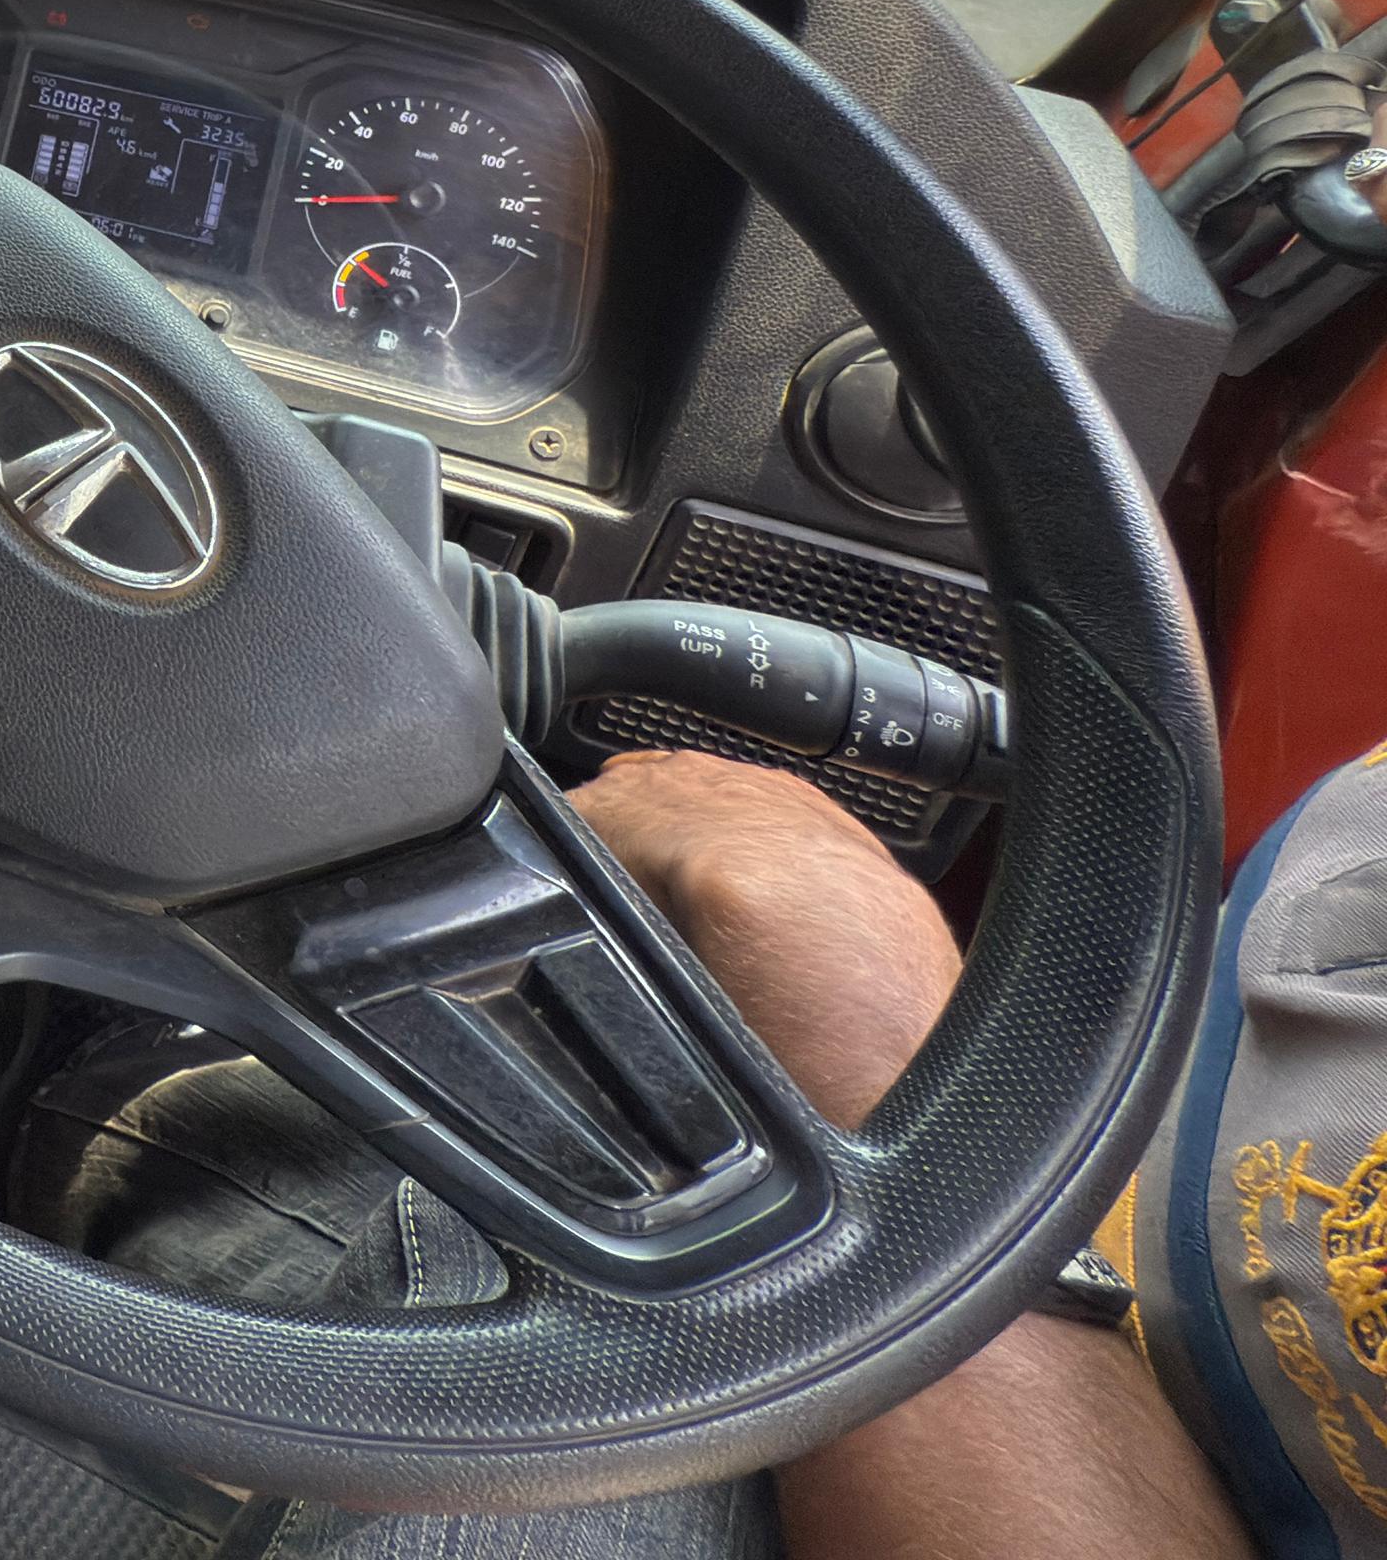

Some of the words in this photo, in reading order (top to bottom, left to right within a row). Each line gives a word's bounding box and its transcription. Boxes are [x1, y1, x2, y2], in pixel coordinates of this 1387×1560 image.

[31, 74, 57, 87] ODO
[159, 102, 200, 118] SERVICE
[399, 111, 419, 125] 60
[353, 125, 374, 140] 40
[449, 121, 469, 136] 80
[325, 157, 345, 171] 20
[481, 153, 507, 170] 100
[499, 196, 525, 214] 120
[491, 233, 517, 250] 140
[389, 267, 414, 281] FUEL
[348, 306, 359, 319] E
[674, 620, 727, 641] PASS
[748, 620, 764, 634] L
[680, 637, 724, 659] (UP)
[750, 673, 765, 689] R
[862, 686, 877, 704] 3
[857, 710, 873, 725] 2
[932, 711, 964, 732] OFF
[853, 731, 863, 743] 1
[845, 746, 860, 758] 0
